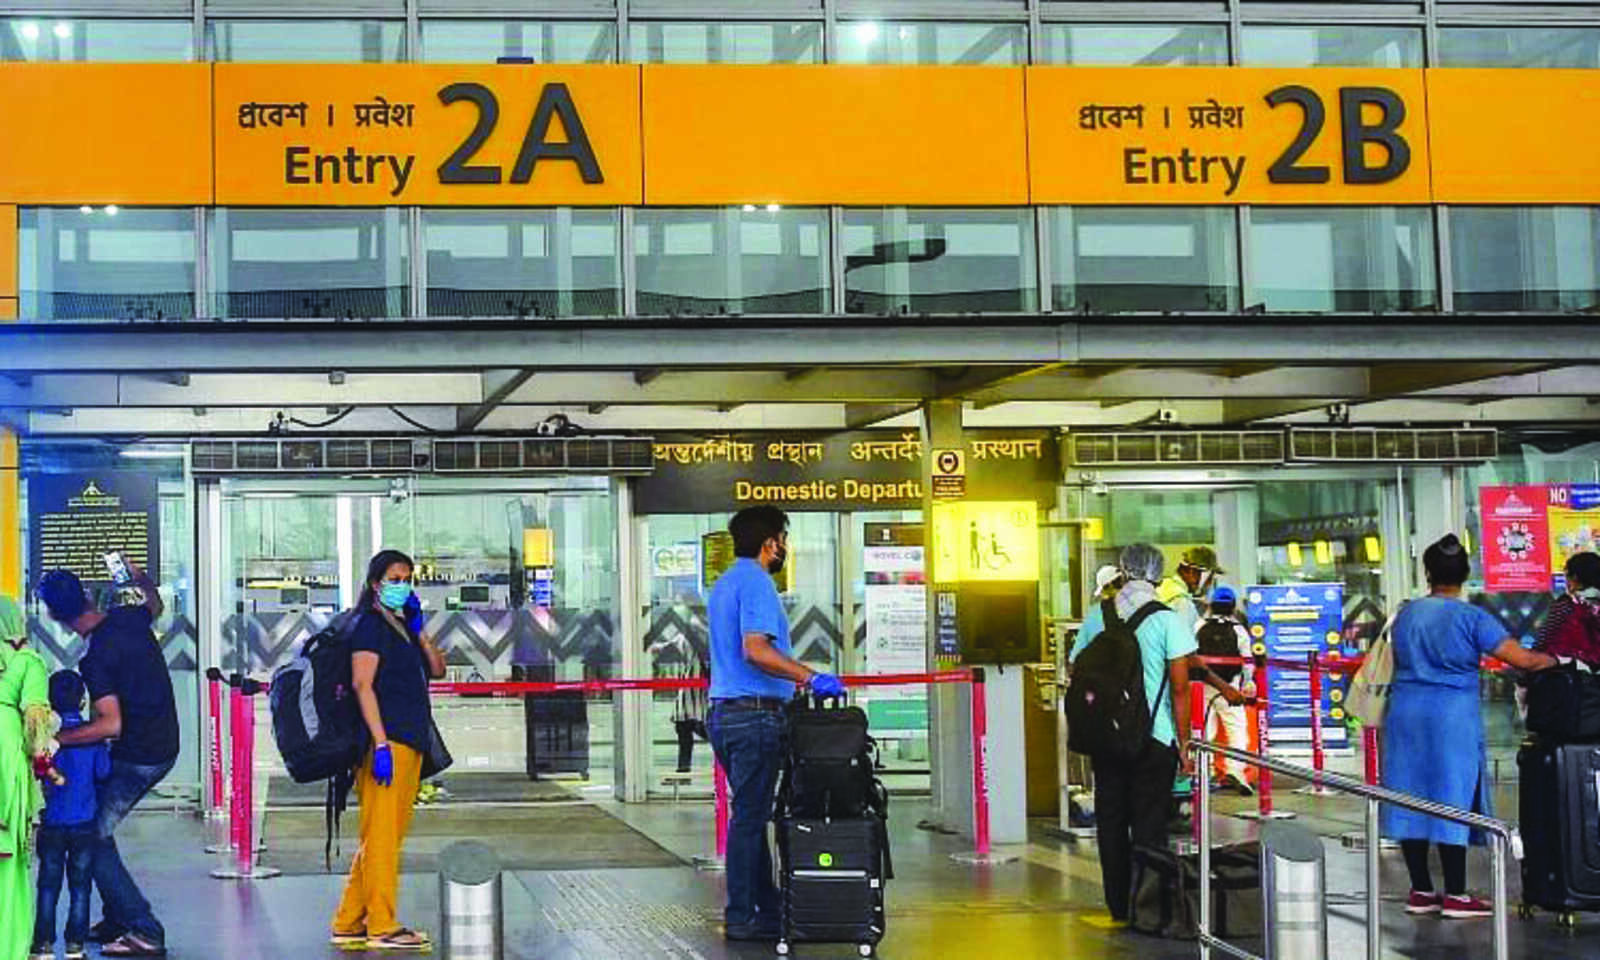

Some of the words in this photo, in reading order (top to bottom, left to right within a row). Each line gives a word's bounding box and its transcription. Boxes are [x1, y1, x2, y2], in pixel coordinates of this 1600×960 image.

[238, 101, 308, 129] প্রবেশ
[353, 95, 415, 128] प्रवेश
[1079, 104, 1144, 130] প্রবেশ
[1188, 99, 1245, 129] प्रवेश
[285, 146, 415, 197] Entry
[436, 82, 605, 186] 2A
[1123, 148, 1246, 197] Entry
[1263, 84, 1412, 186] 2B
[971, 438, 1042, 460] प्रस्थान
[736, 480, 838, 500] Domestic
[843, 479, 923, 502] Departu
[1550, 487, 1567, 503] NO
